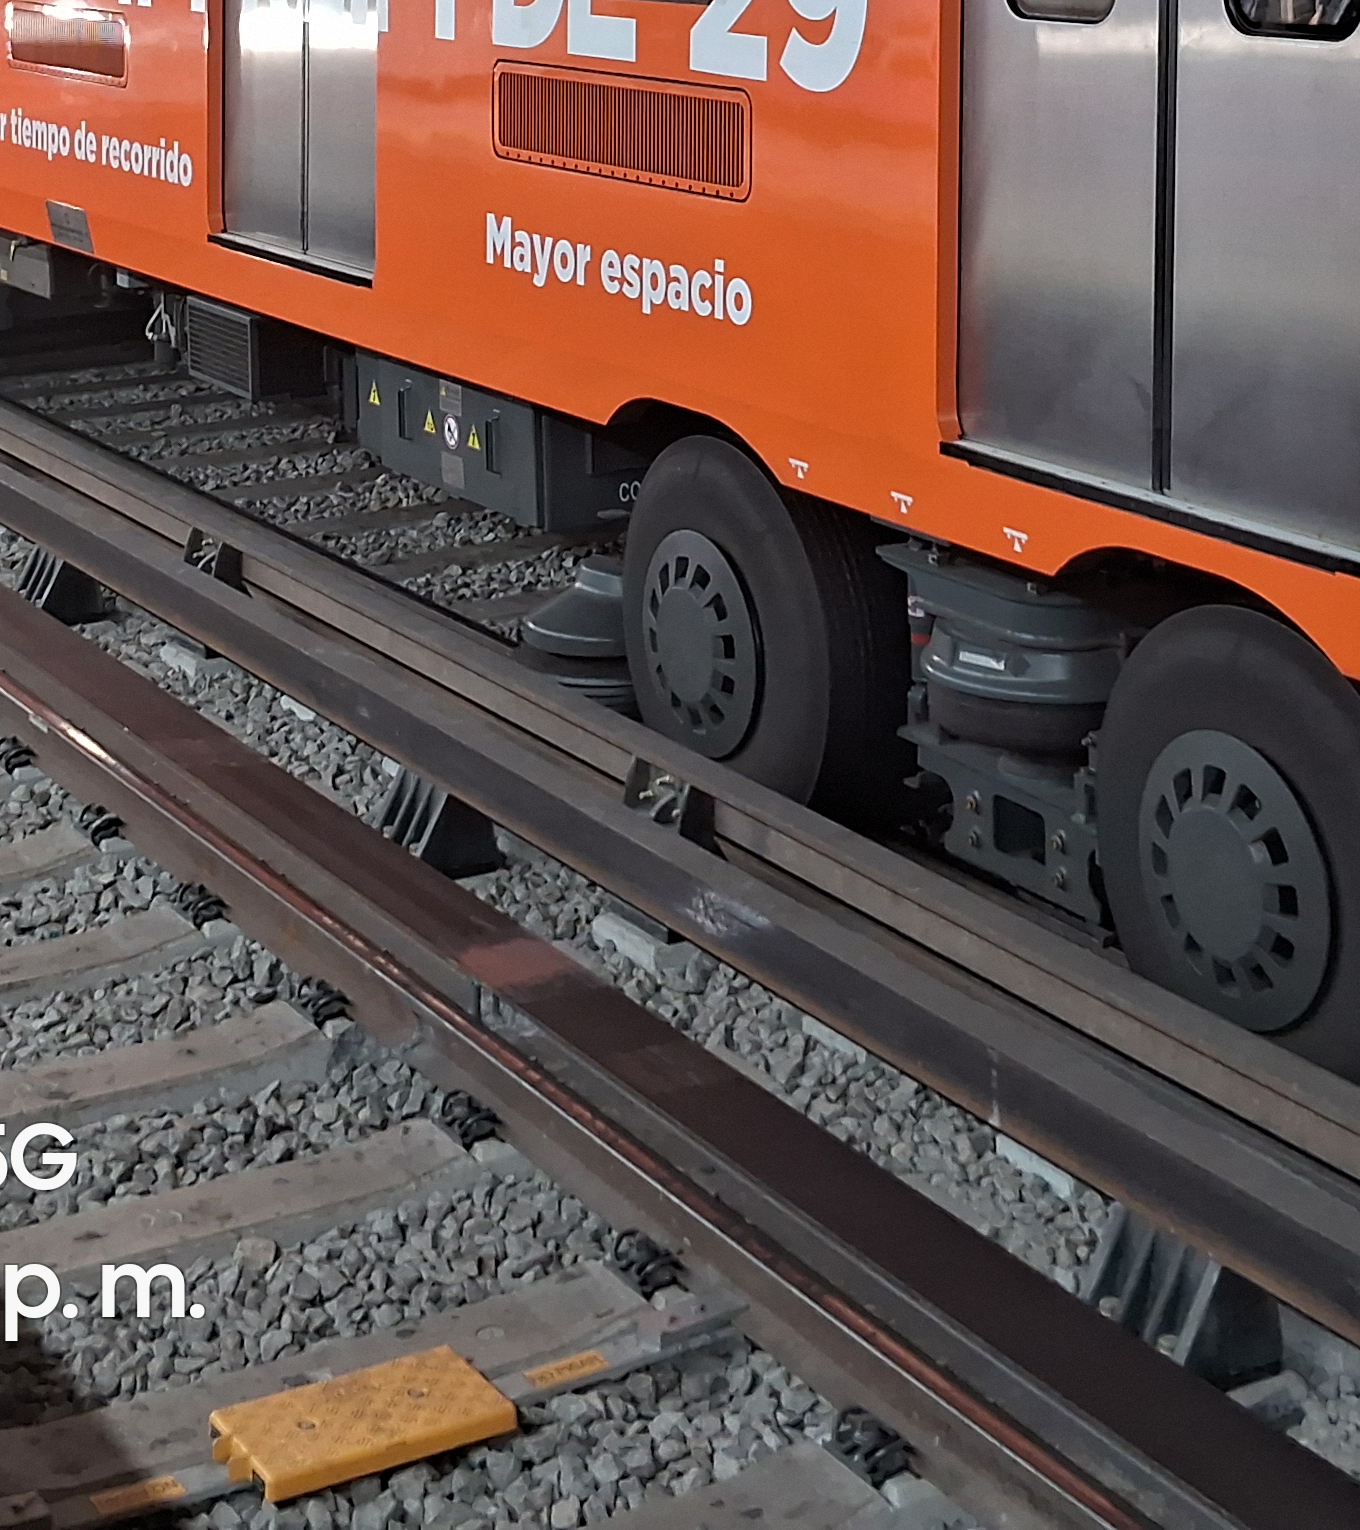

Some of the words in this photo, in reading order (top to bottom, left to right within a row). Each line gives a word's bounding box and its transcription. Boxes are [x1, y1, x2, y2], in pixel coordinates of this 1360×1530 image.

[10, 107, 71, 162] tiempo
[73, 120, 97, 163] de
[101, 137, 194, 187] recorrido
[485, 212, 591, 288] Mayor
[601, 248, 753, 326] espacio
